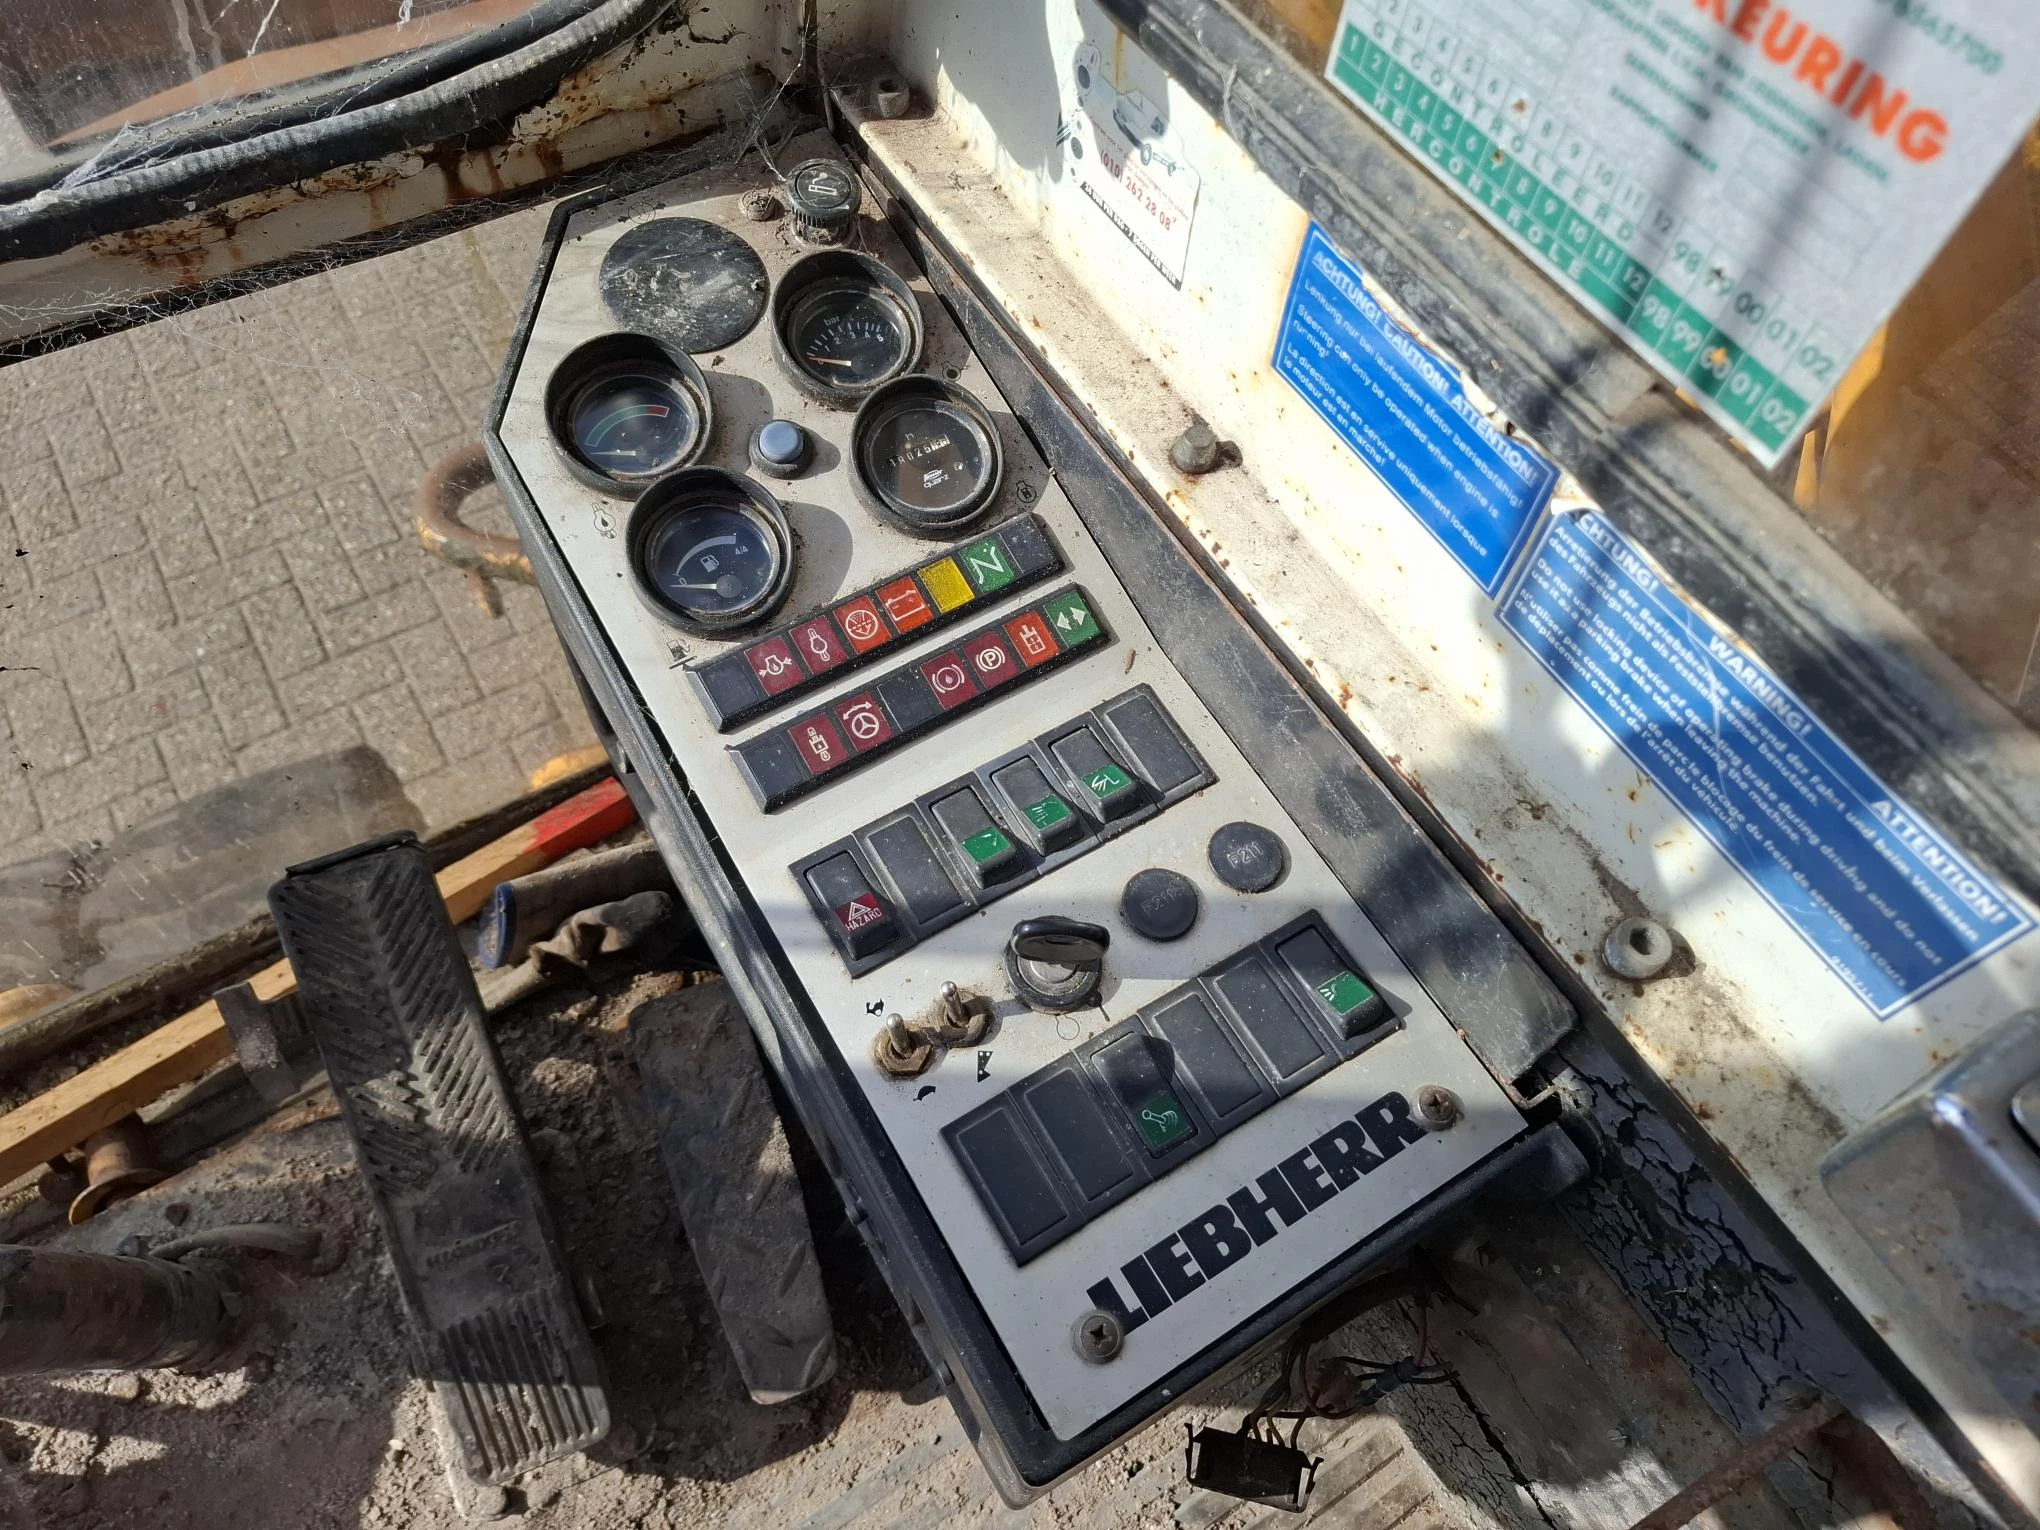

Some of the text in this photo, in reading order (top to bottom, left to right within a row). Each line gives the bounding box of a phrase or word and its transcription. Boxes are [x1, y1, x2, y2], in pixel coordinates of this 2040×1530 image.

[1100, 150, 1123, 183] (010)
[1125, 175, 1142, 202] 262
[1144, 196, 1156, 216] 28
[1159, 210, 1170, 231] 08
[1370, 52, 1383, 73] 2
[1393, 72, 1407, 92] 3
[1416, 95, 1430, 112] 4
[1441, 114, 1455, 132] 5
[1465, 136, 1477, 153] 6
[1515, 176, 1530, 195] 8
[1543, 198, 1558, 216] 9
[1568, 219, 1588, 244] 10
[1595, 243, 1614, 266] 11
[1623, 266, 1646, 292] 12
[1642, 295, 1673, 329] 98
[1671, 320, 1702, 353] 99
[1730, 372, 1764, 405] 01
[1761, 398, 1798, 435] 02
[1596, 163, 1615, 187] 10
[1623, 185, 1643, 208] 11
[1654, 208, 1673, 235] 12
[1672, 241, 1702, 273] 98
[1734, 292, 1766, 325] 00
[1766, 319, 1797, 350] 01
[1800, 345, 1834, 383] 02
[823, 316, 840, 327] bar
[1283, 355, 1385, 465] le moteur est en marche!
[1293, 319, 1329, 357] running!
[1297, 303, 1498, 518] Steering can only be operated when engine is
[1304, 279, 1342, 324] Lenkung
[1342, 320, 1359, 337] nur
[1374, 351, 1422, 406] laufendem
[1423, 403, 1452, 435] Motor
[1313, 251, 1380, 323] ACHTUNG!
[1450, 394, 1536, 483] ATTENTION!
[735, 545, 748, 555] 4/4
[1287, 342, 1298, 358] La
[1299, 356, 1335, 396] direction
[1335, 395, 1350, 412] est
[1350, 411, 1362, 425] en
[1395, 458, 1450, 518] uniquement
[1450, 514, 1487, 556] lorsque
[1514, 600, 1527, 614] de
[1590, 680, 1605, 695] ou
[1605, 693, 1625, 717] lors
[1626, 717, 1640, 731] de
[1674, 766, 1689, 782] du
[1531, 570, 1549, 589] use
[1549, 587, 1558, 599] it
[1570, 611, 1578, 619] a
[1577, 619, 1625, 662] parking
[1620, 658, 1651, 693] brake
[1652, 692, 1684, 725] when
[1684, 724, 1727, 772] leaving
[1728, 768, 1748, 790] the
[1748, 790, 1800, 842] machine.
[1537, 558, 1941, 964] Do not use locking device of operating brake during driving and do not
[1549, 537, 1567, 558] des
[1567, 554, 1622, 612] Fahrzeugs
[1622, 611, 1651, 640] nicht
[1651, 640, 1667, 657] als
[1757, 742, 1818, 804] benutzen.
[1554, 526, 1617, 590] Arretierung
[1618, 588, 1638, 608] der
[1639, 608, 1728, 695] Betriebsbremse
[1786, 752, 1808, 773] der
[1809, 775, 1845, 811] Fahrt
[1845, 812, 1875, 838] und
[1873, 838, 1910, 874] beim
[1912, 875, 1977, 941] Verlassen
[1574, 514, 2005, 921] CHTUNG! WARNING! ATTENTION!
[1226, 841, 1264, 869] F211
[1562, 636, 1582, 656] pas
[1583, 656, 1620, 695] comme
[1621, 693, 1646, 721] frein
[1647, 722, 1662, 737] de
[1661, 738, 1688, 764] parc
[1687, 762, 1699, 775] le
[1700, 774, 1745, 822] blocage
[1746, 823, 1762, 840] du
[1763, 840, 1792, 870] frein
[1792, 871, 1808, 887] de
[1809, 889, 1852, 931] service
[1852, 933, 1869, 949] en
[1870, 951, 1905, 986] cours
[845, 907, 883, 933] HAZARD
[1086, 1091, 1430, 1336] LIEBHERR
